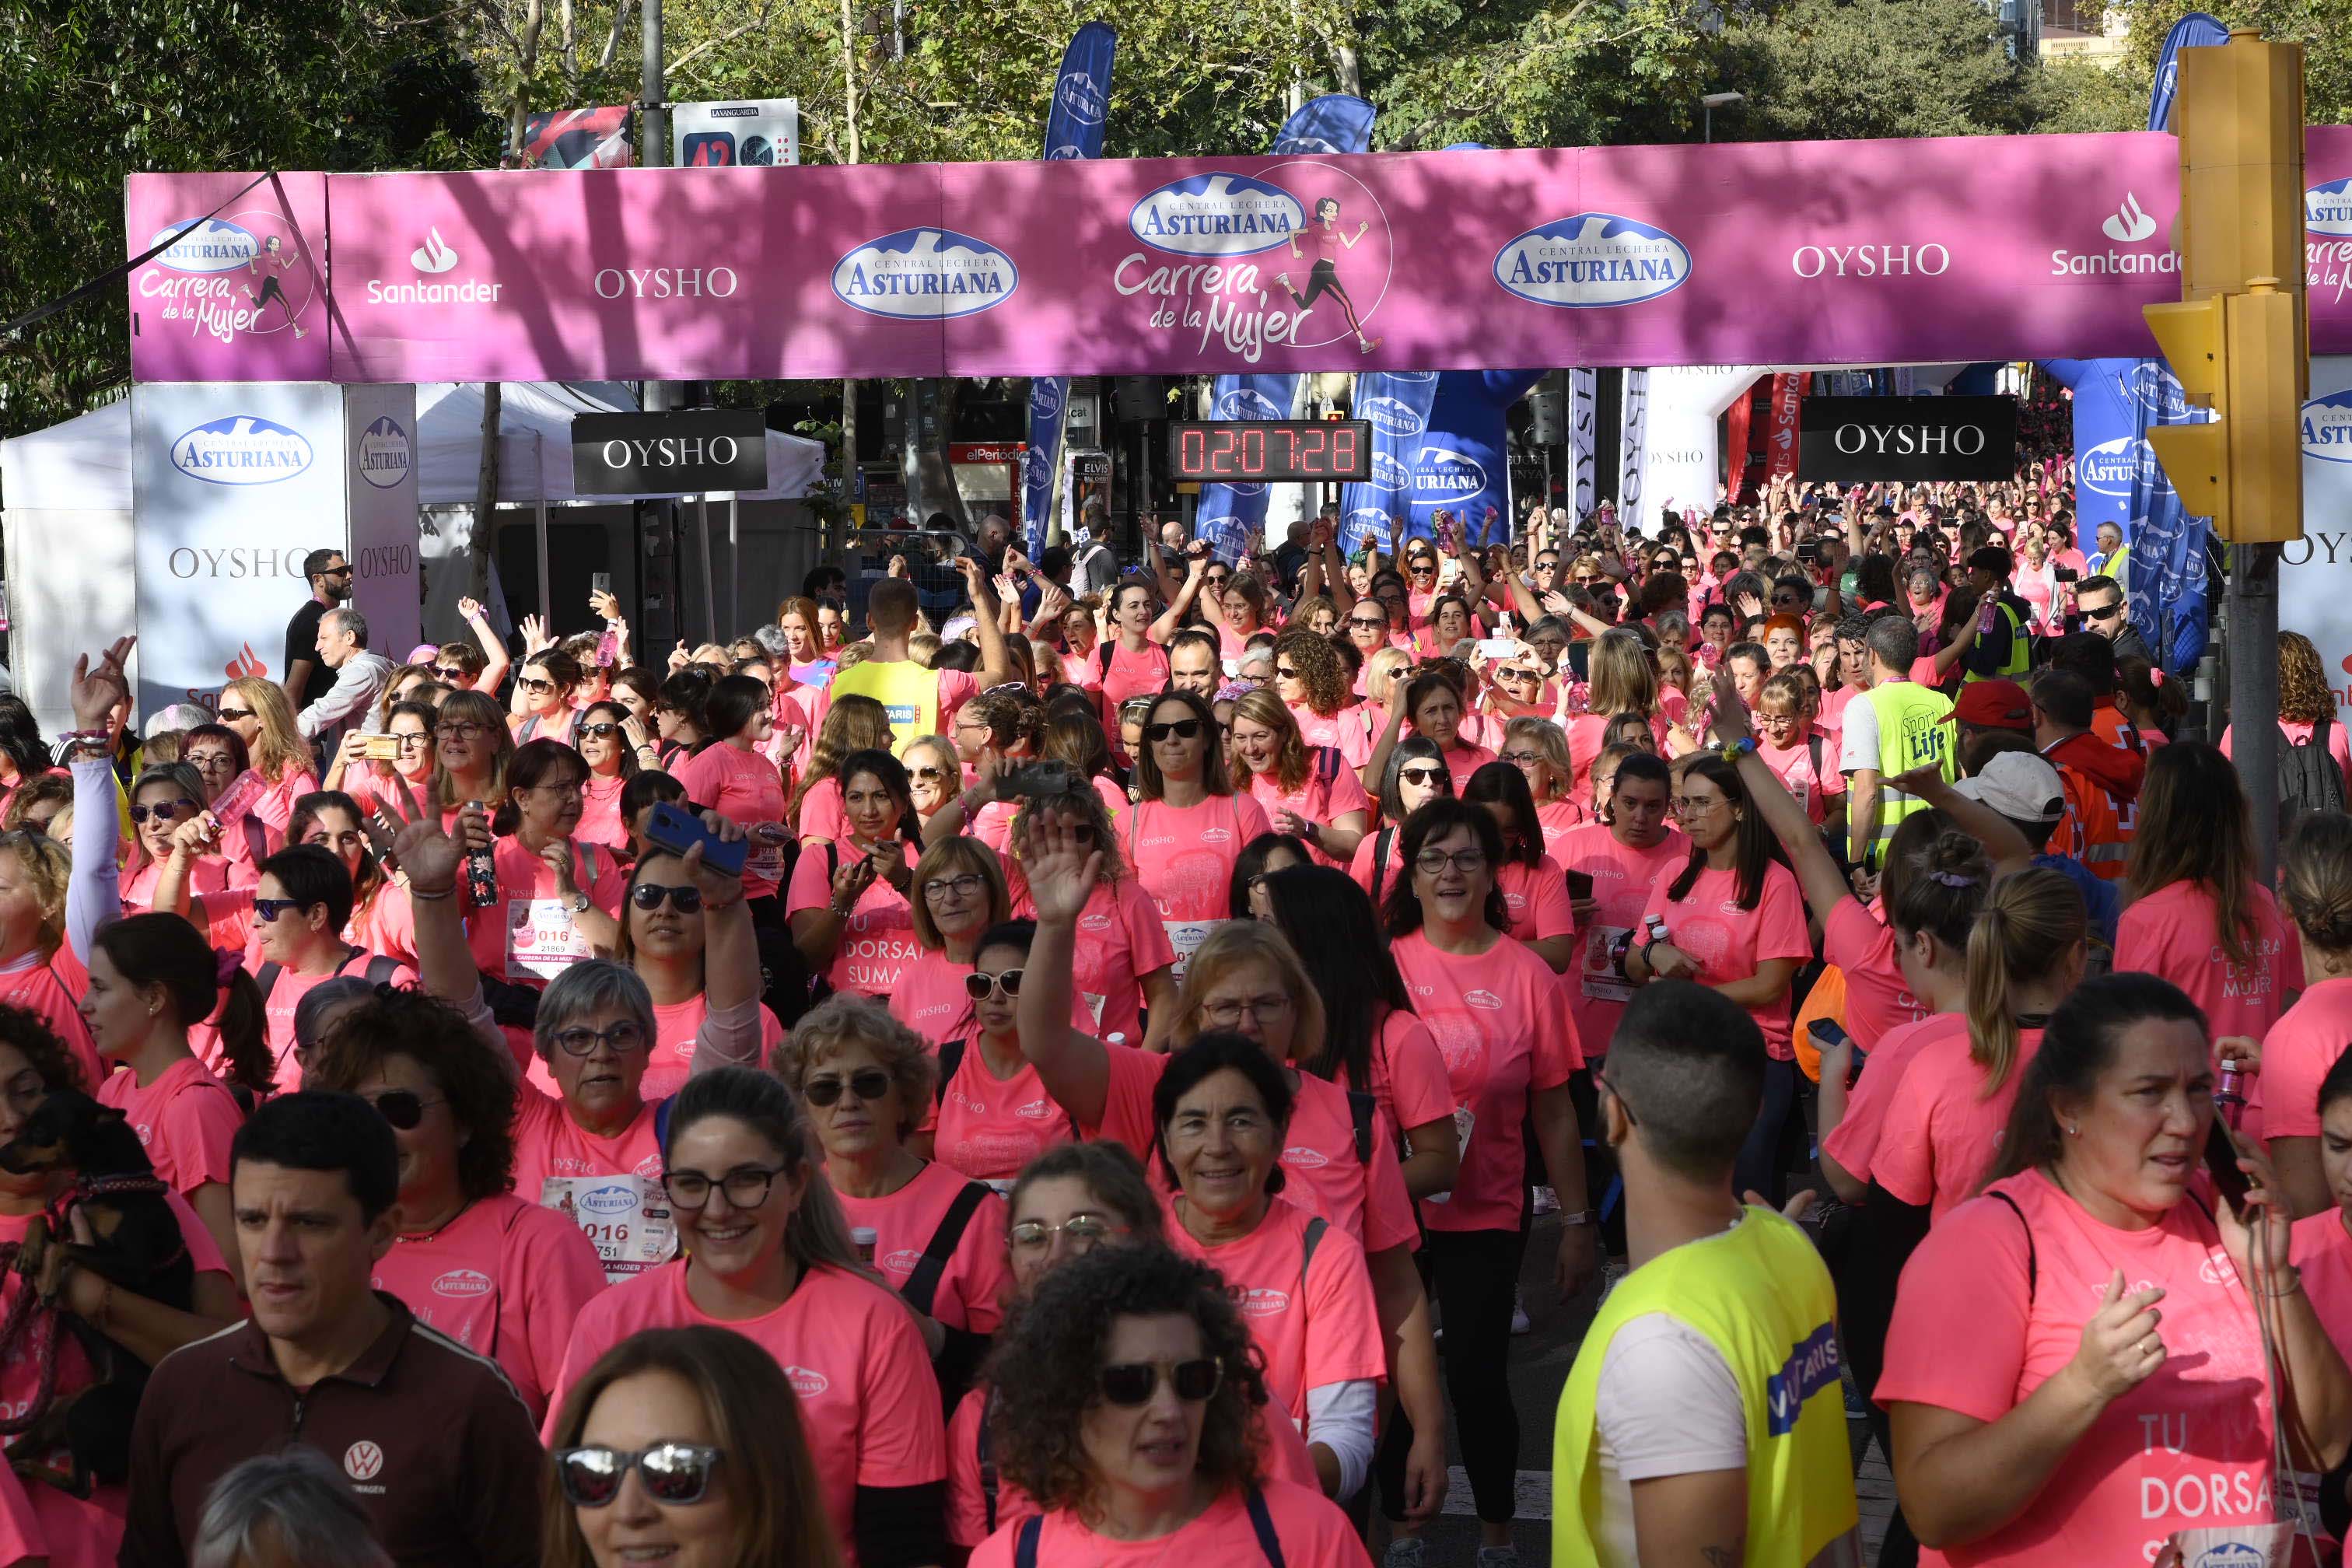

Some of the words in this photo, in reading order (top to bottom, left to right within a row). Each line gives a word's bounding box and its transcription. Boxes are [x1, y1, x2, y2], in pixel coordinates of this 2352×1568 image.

[1169, 200, 1223, 210] CENTRAL
[1230, 199, 1286, 209] LECHERA
[1143, 205, 1293, 235] ASTURIANA
[874, 259, 933, 268] CENTRAL
[939, 258, 997, 268] LECHERA
[1539, 246, 1600, 256] CENTRAL
[1607, 244, 1669, 254] LECHERA
[1792, 243, 1950, 278] OYSHO
[846, 262, 1004, 296] ASTURIANA
[1114, 253, 1258, 296] Carrera
[1509, 249, 1676, 284] ASTURIANA
[2324, 264, 2338, 286] la
[139, 269, 231, 298] Carrera
[367, 278, 502, 305] Santander
[594, 267, 738, 299] OYSHO
[162, 299, 180, 320] de
[182, 299, 194, 320] la
[193, 295, 265, 344] Mujer
[1150, 298, 1176, 328] de
[1182, 296, 1202, 327] la
[1198, 290, 1313, 363] Mujer
[1362, 404, 1416, 432] ASTURIANA
[604, 436, 737, 468] OYSHO
[1182, 429, 1355, 472] 02:07:28
[1835, 423, 1985, 454] OYSHO
[181, 442, 303, 467] ASTURIANA
[362, 443, 408, 471] ASTURIANA
[1084, 463, 1108, 474] ELVIS
[360, 544, 412, 579] OYSHO
[2278, 532, 2352, 565] OY
[168, 548, 310, 579] OYSHO
[1902, 709, 1937, 738] Sport
[1910, 726, 1944, 761] Life
[1141, 835, 1175, 847] OYSHO
[1591, 870, 1624, 880] OYSHO
[538, 930, 569, 942] 016
[2222, 976, 2272, 998] MUJER
[915, 1003, 951, 1019] OYSHO
[1465, 996, 1500, 1008] ASTURIANA
[584, 1197, 633, 1209] ASTURIANA
[584, 1223, 628, 1241] 016
[437, 1278, 487, 1291] ASTURIANA
[2138, 1412, 2186, 1456] TU
